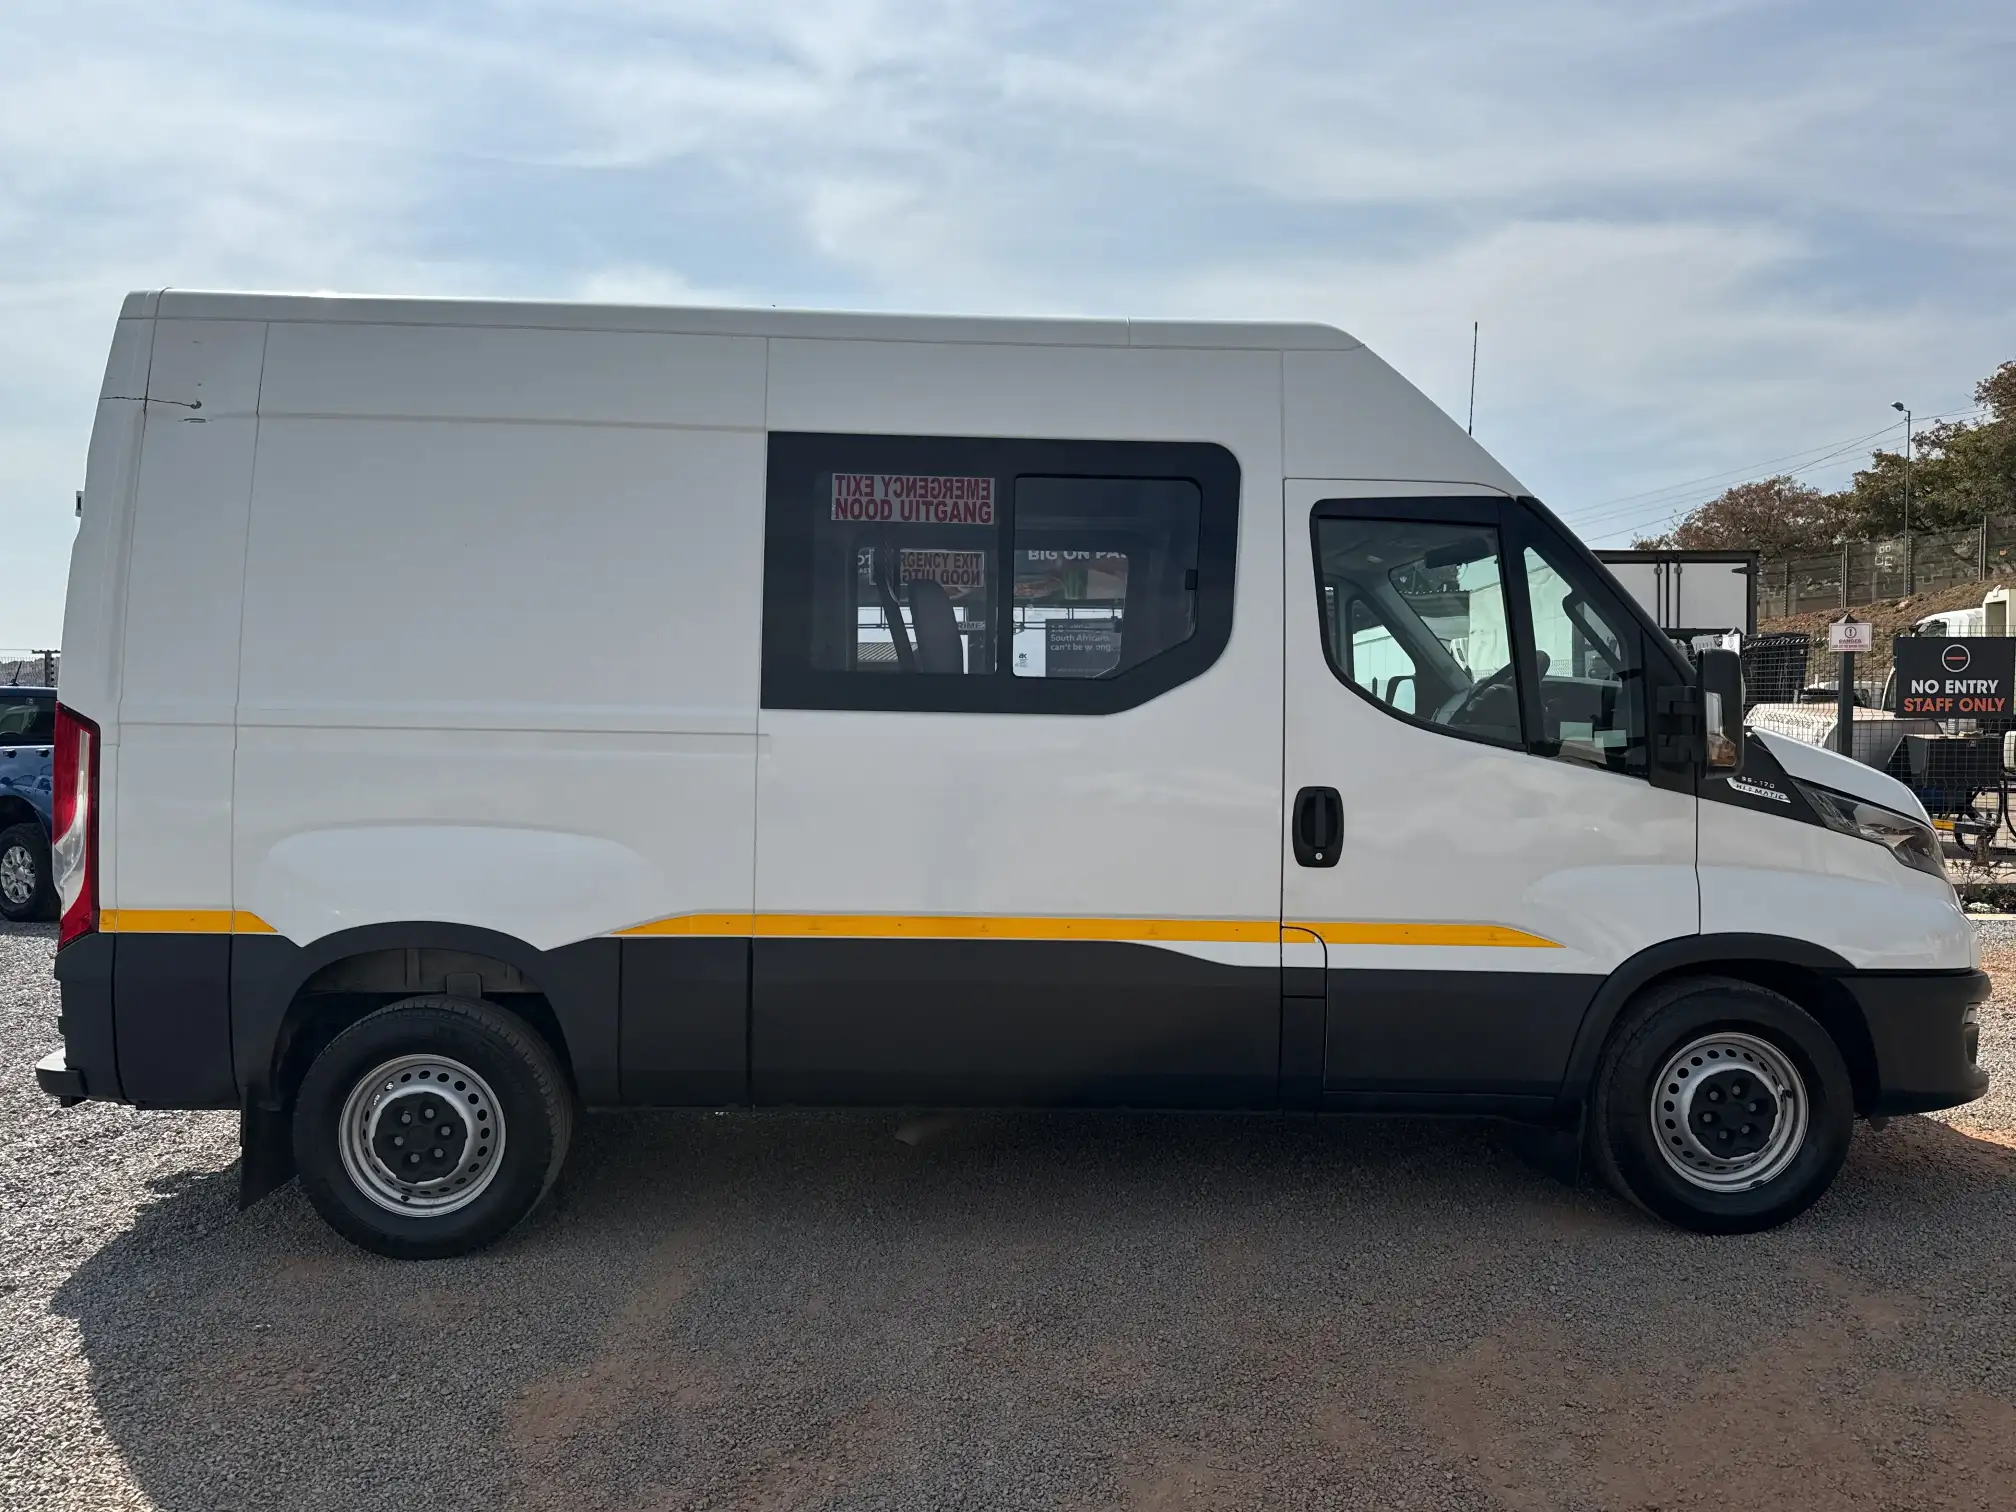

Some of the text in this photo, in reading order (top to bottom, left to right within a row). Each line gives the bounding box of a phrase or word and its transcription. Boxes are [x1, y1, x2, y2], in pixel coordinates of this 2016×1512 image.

[835, 498, 992, 523] NOOD UITGANG
[953, 553, 981, 569] EXIT
[1028, 550, 1058, 561] BIG
[1050, 634, 1075, 642] South
[1050, 643, 1071, 651] can't
[1073, 643, 1083, 651] be
[1911, 679, 1999, 694] NO ENTRY
[1903, 697, 2006, 712] STAFF ONLY
